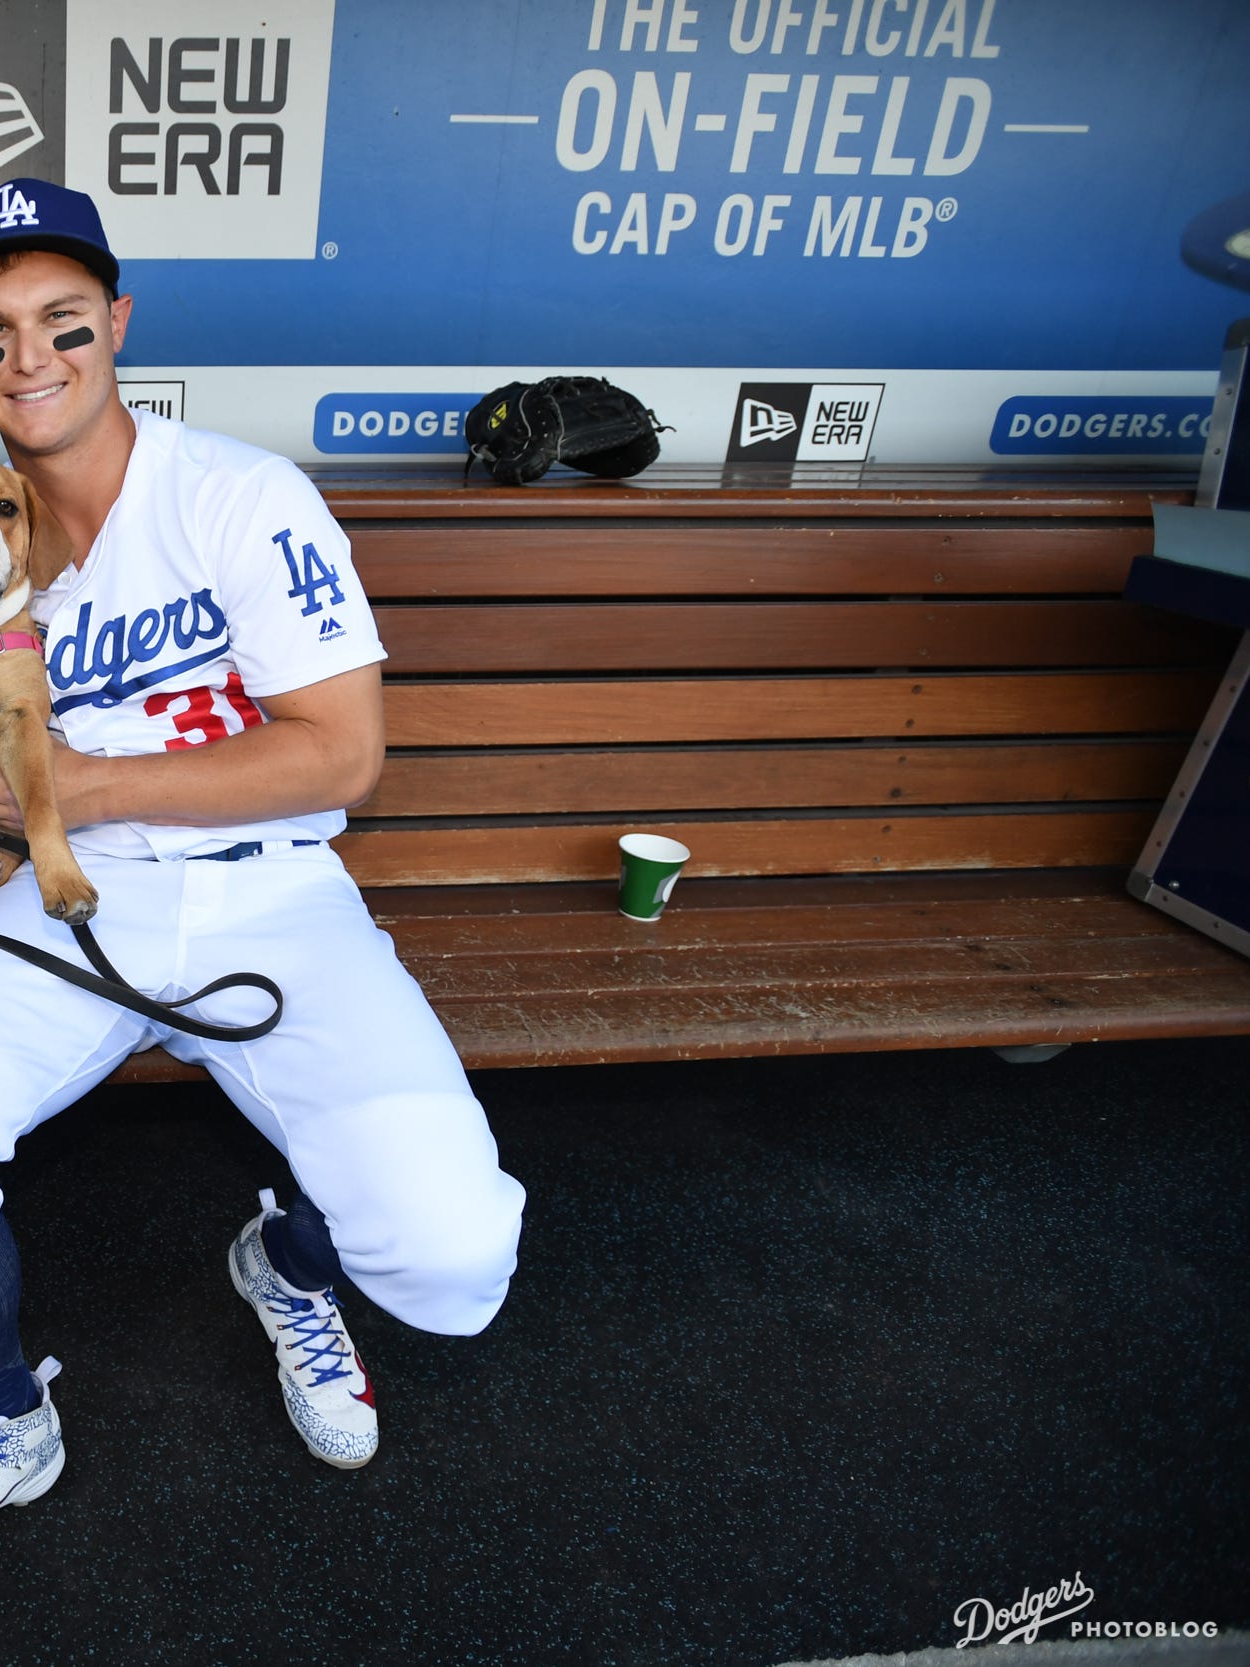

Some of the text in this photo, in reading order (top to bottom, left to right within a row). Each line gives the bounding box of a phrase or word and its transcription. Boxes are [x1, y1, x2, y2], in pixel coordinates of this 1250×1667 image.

[587, 0, 1001, 58] THE OFFICIAL
[109, 37, 291, 114] NEW
[108, 122, 284, 196] ERA
[554, 68, 993, 177] ON-FIELD
[572, 191, 697, 255] CAP
[713, 193, 792, 256] OF
[811, 424, 863, 445] ERA
[816, 401, 870, 422] NEW
[271, 528, 346, 617] LA
[44, 588, 229, 708] dgers
